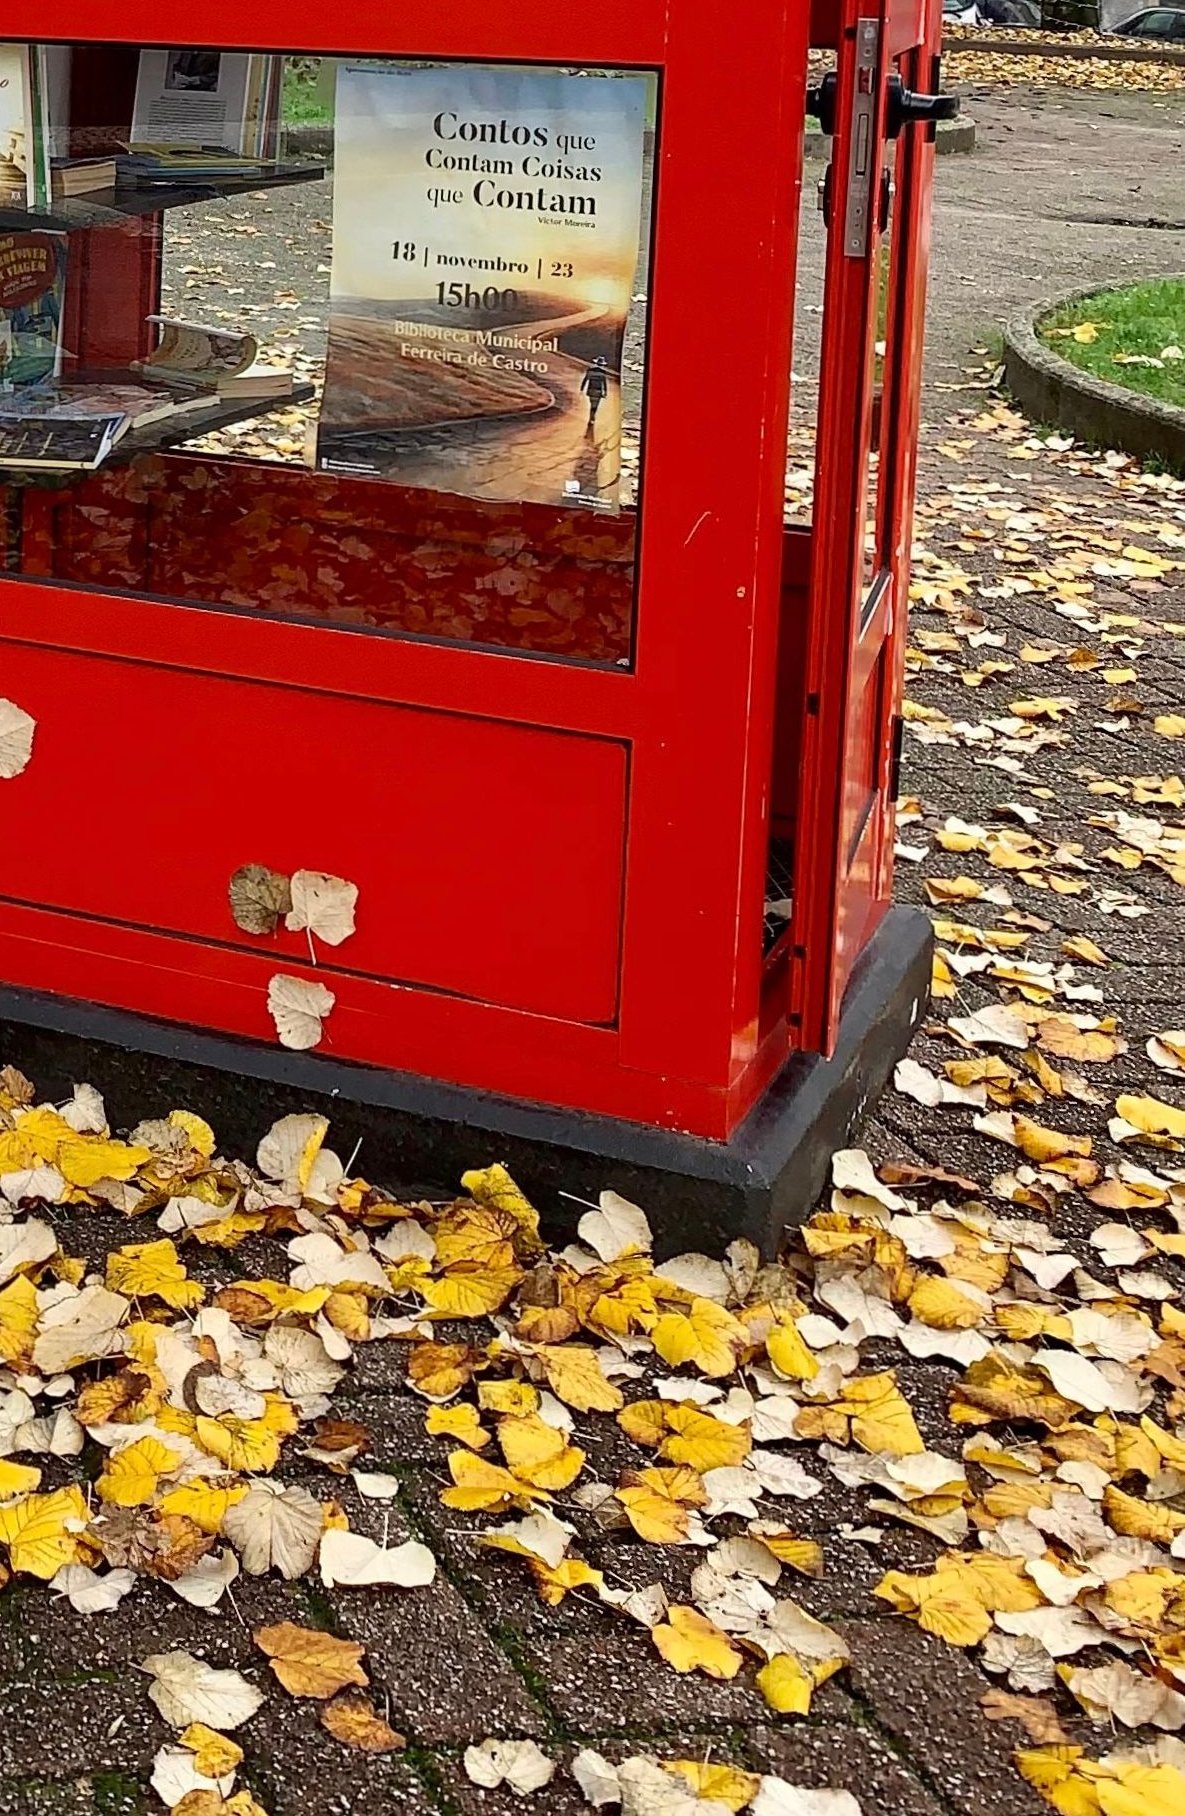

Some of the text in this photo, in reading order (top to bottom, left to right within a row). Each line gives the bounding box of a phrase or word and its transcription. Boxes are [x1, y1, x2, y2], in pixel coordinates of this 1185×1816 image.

[433, 112, 596, 155] Contos que
[425, 148, 602, 182] Contam Coisas
[427, 179, 597, 216] que Contam
[564, 218, 596, 229] Moreira
[391, 240, 416, 262] 18
[436, 250, 529, 274] novembro
[550, 262, 574, 279] 23
[435, 281, 518, 311] 15h00
[394, 320, 558, 353] Biblioteca Municipal
[401, 343, 548, 374] Ferreira de Castro
